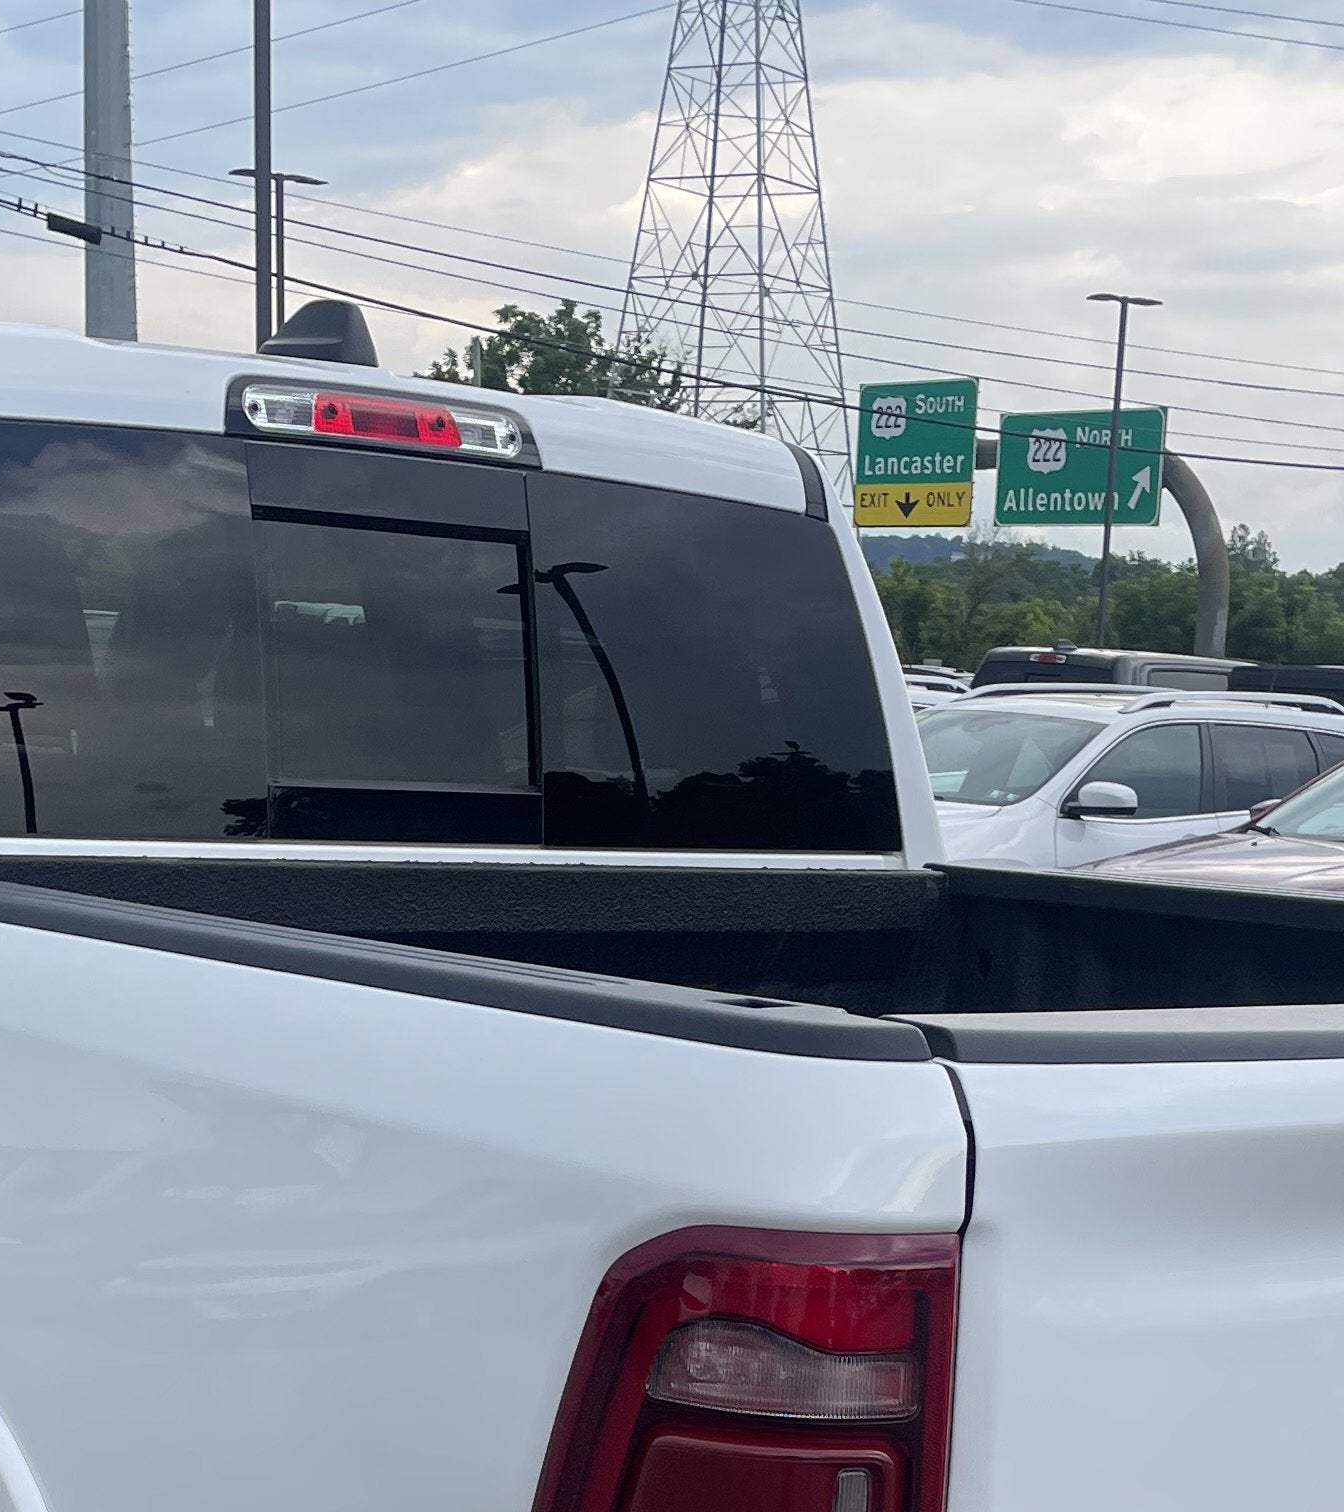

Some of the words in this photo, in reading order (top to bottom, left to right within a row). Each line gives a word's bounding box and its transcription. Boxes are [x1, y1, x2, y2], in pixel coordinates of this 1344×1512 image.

[915, 394, 965, 414] SOUTH
[876, 406, 902, 429] 222
[1075, 426, 1133, 448] NORH
[1032, 438, 1063, 463] 222
[864, 452, 966, 476] Lancaster
[860, 493, 889, 508] EXIT
[926, 491, 966, 508] ONLY
